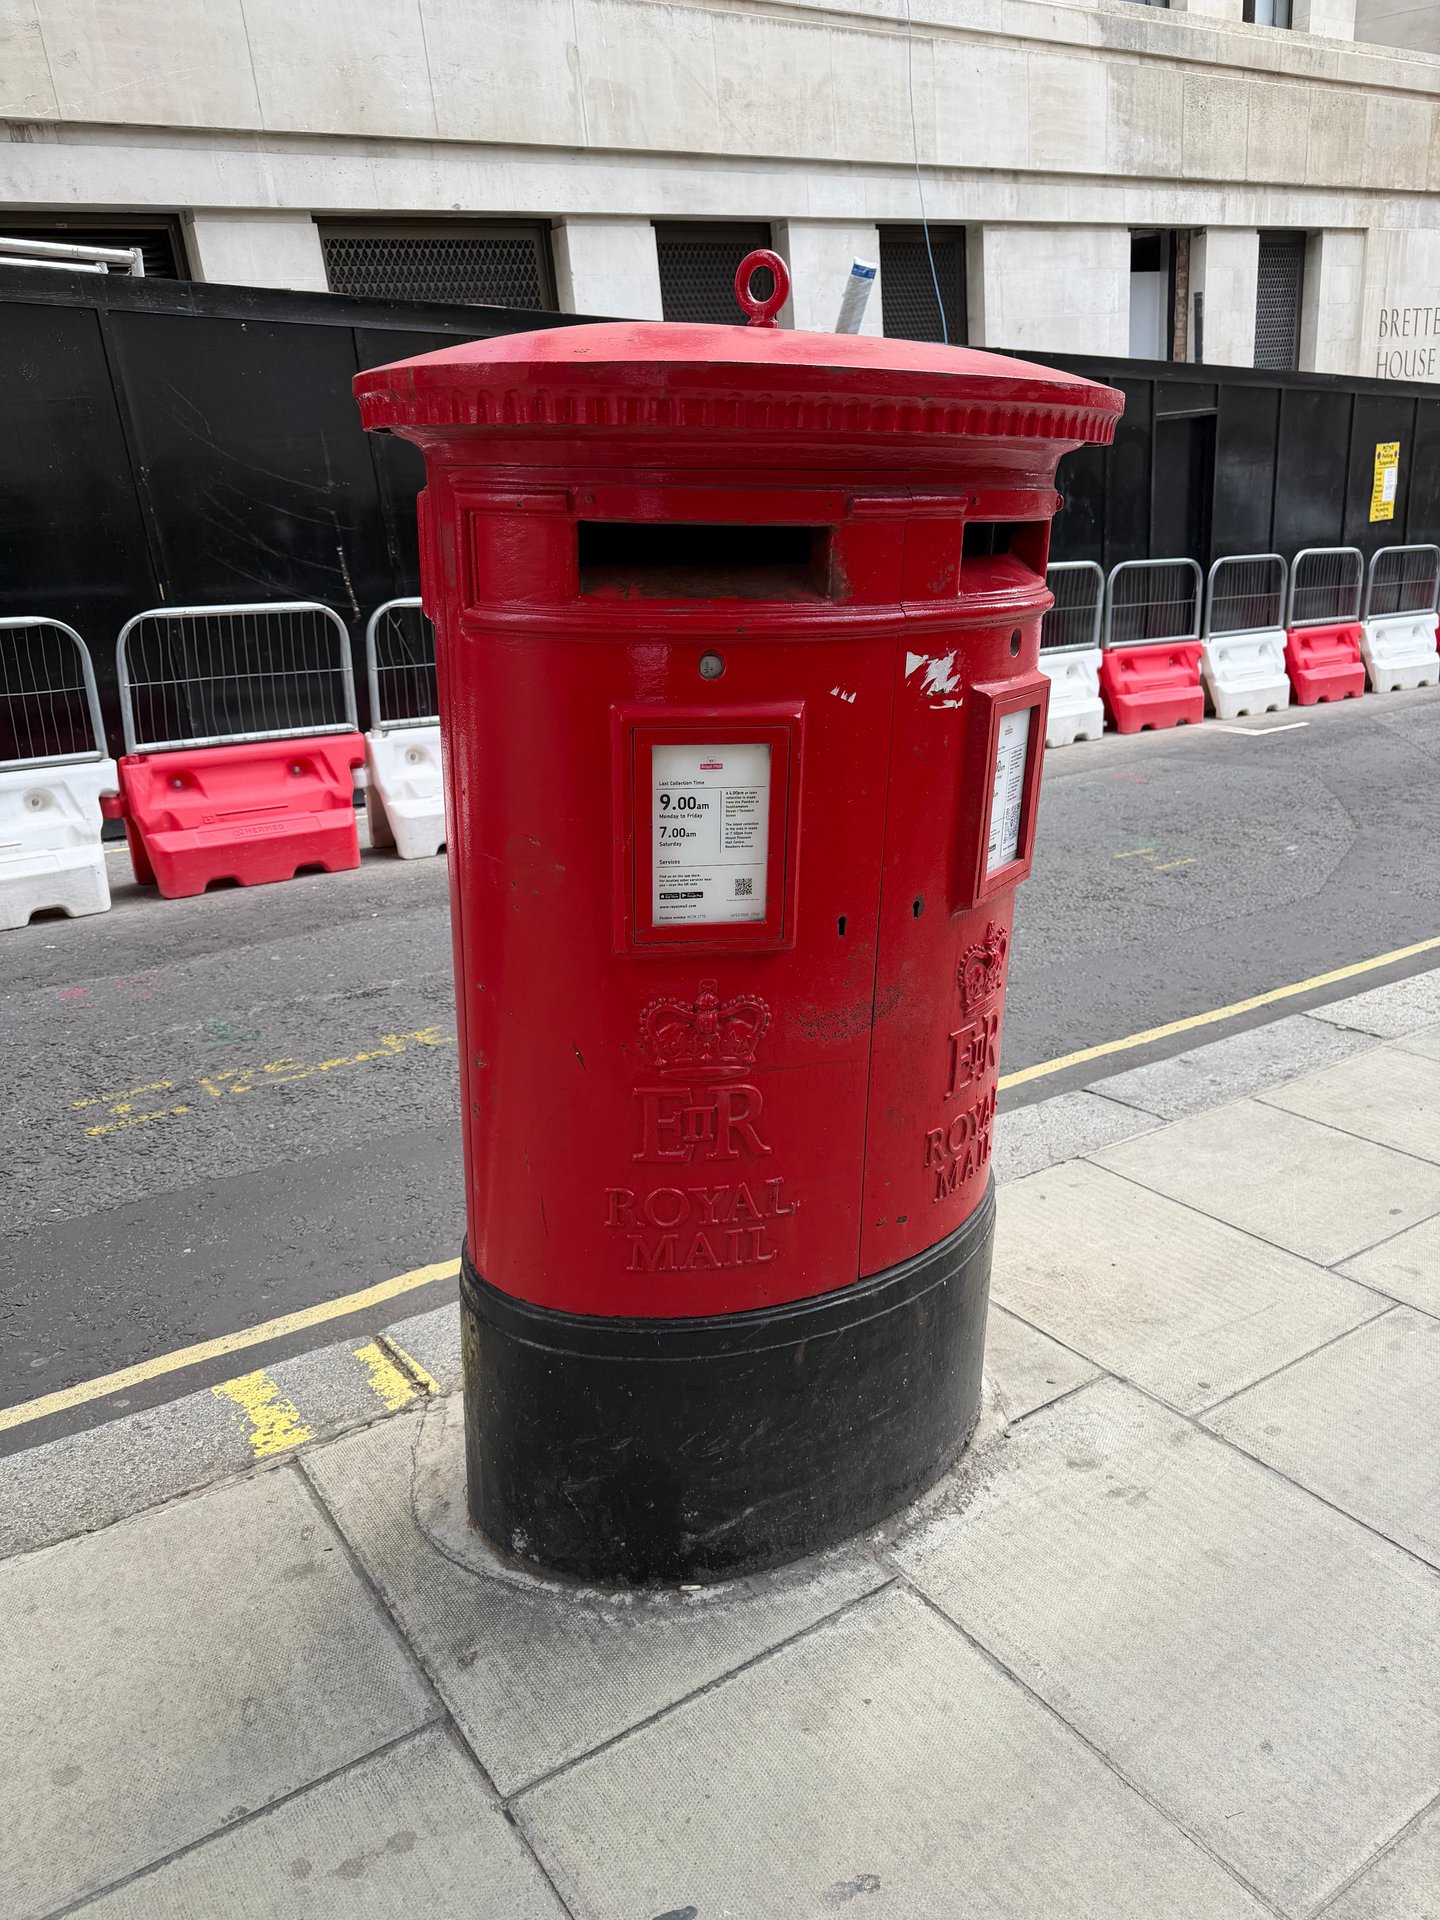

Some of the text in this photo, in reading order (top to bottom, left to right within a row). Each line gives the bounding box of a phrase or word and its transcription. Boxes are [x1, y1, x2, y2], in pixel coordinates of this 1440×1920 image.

[1376, 349, 1436, 378] HOUSE
[660, 794, 709, 810] 9.00am
[659, 827, 696, 838] 7.00am
[925, 1083, 997, 1167] ROYAL
[933, 1127, 992, 1203] MAIL
[603, 1177, 795, 1228] ROYAL
[626, 1226, 778, 1272] MAIL
